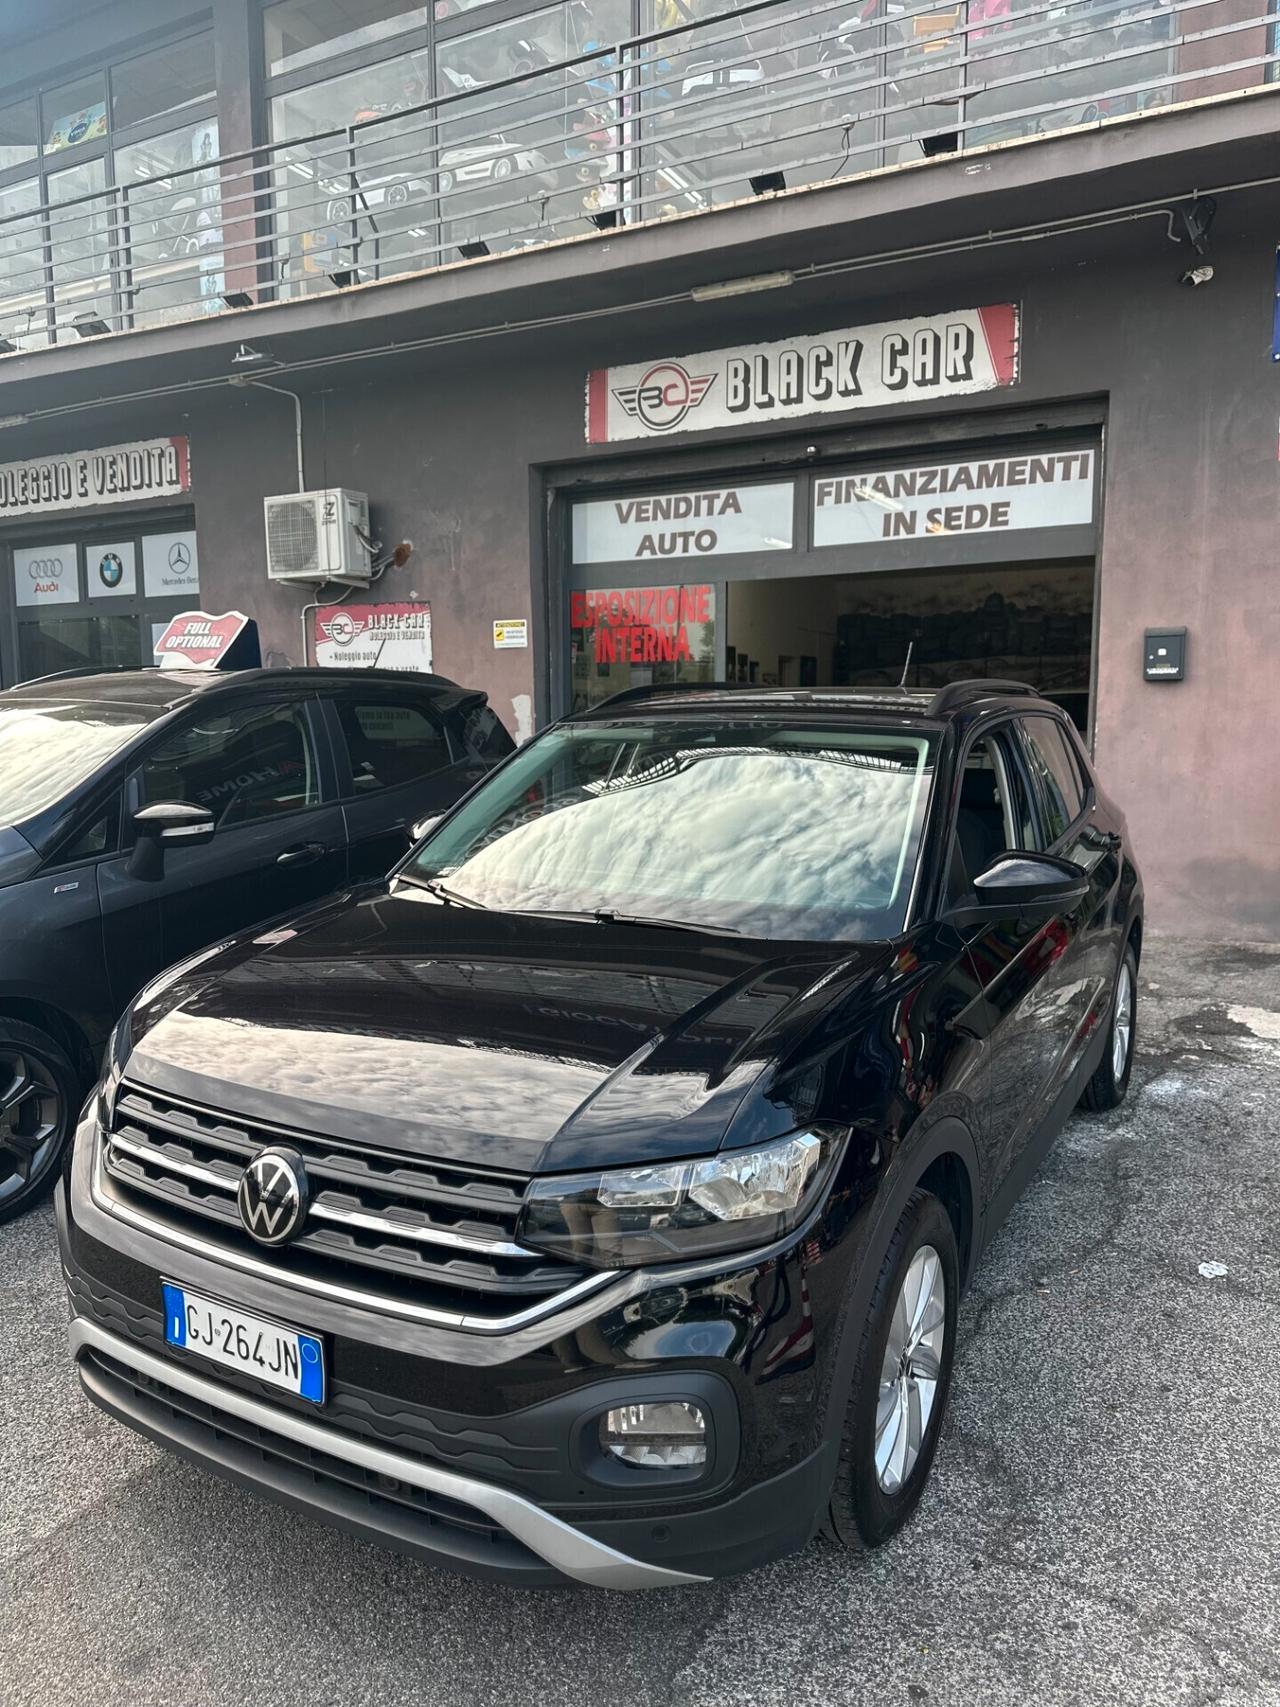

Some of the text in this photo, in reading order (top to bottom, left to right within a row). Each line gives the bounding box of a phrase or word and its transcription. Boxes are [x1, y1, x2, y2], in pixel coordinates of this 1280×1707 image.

[726, 323, 974, 413] BLACK CAR
[76, 459, 88, 497] E
[92, 445, 180, 495] VENDITA
[816, 453, 1090, 507] FINANZIAMENTI
[615, 492, 742, 524] VENDITA
[882, 501, 1011, 537] IN SEDE
[635, 529, 717, 557] AUTO
[34, 582, 59, 593] Audi
[368, 614, 400, 629] BLACK
[571, 584, 711, 628] ESPOSIZIONE
[165, 635, 224, 648] OPTIONAL
[184, 622, 212, 634] FULL
[595, 625, 690, 663] INTERNA
[334, 651, 377, 662] Noleggio auto
